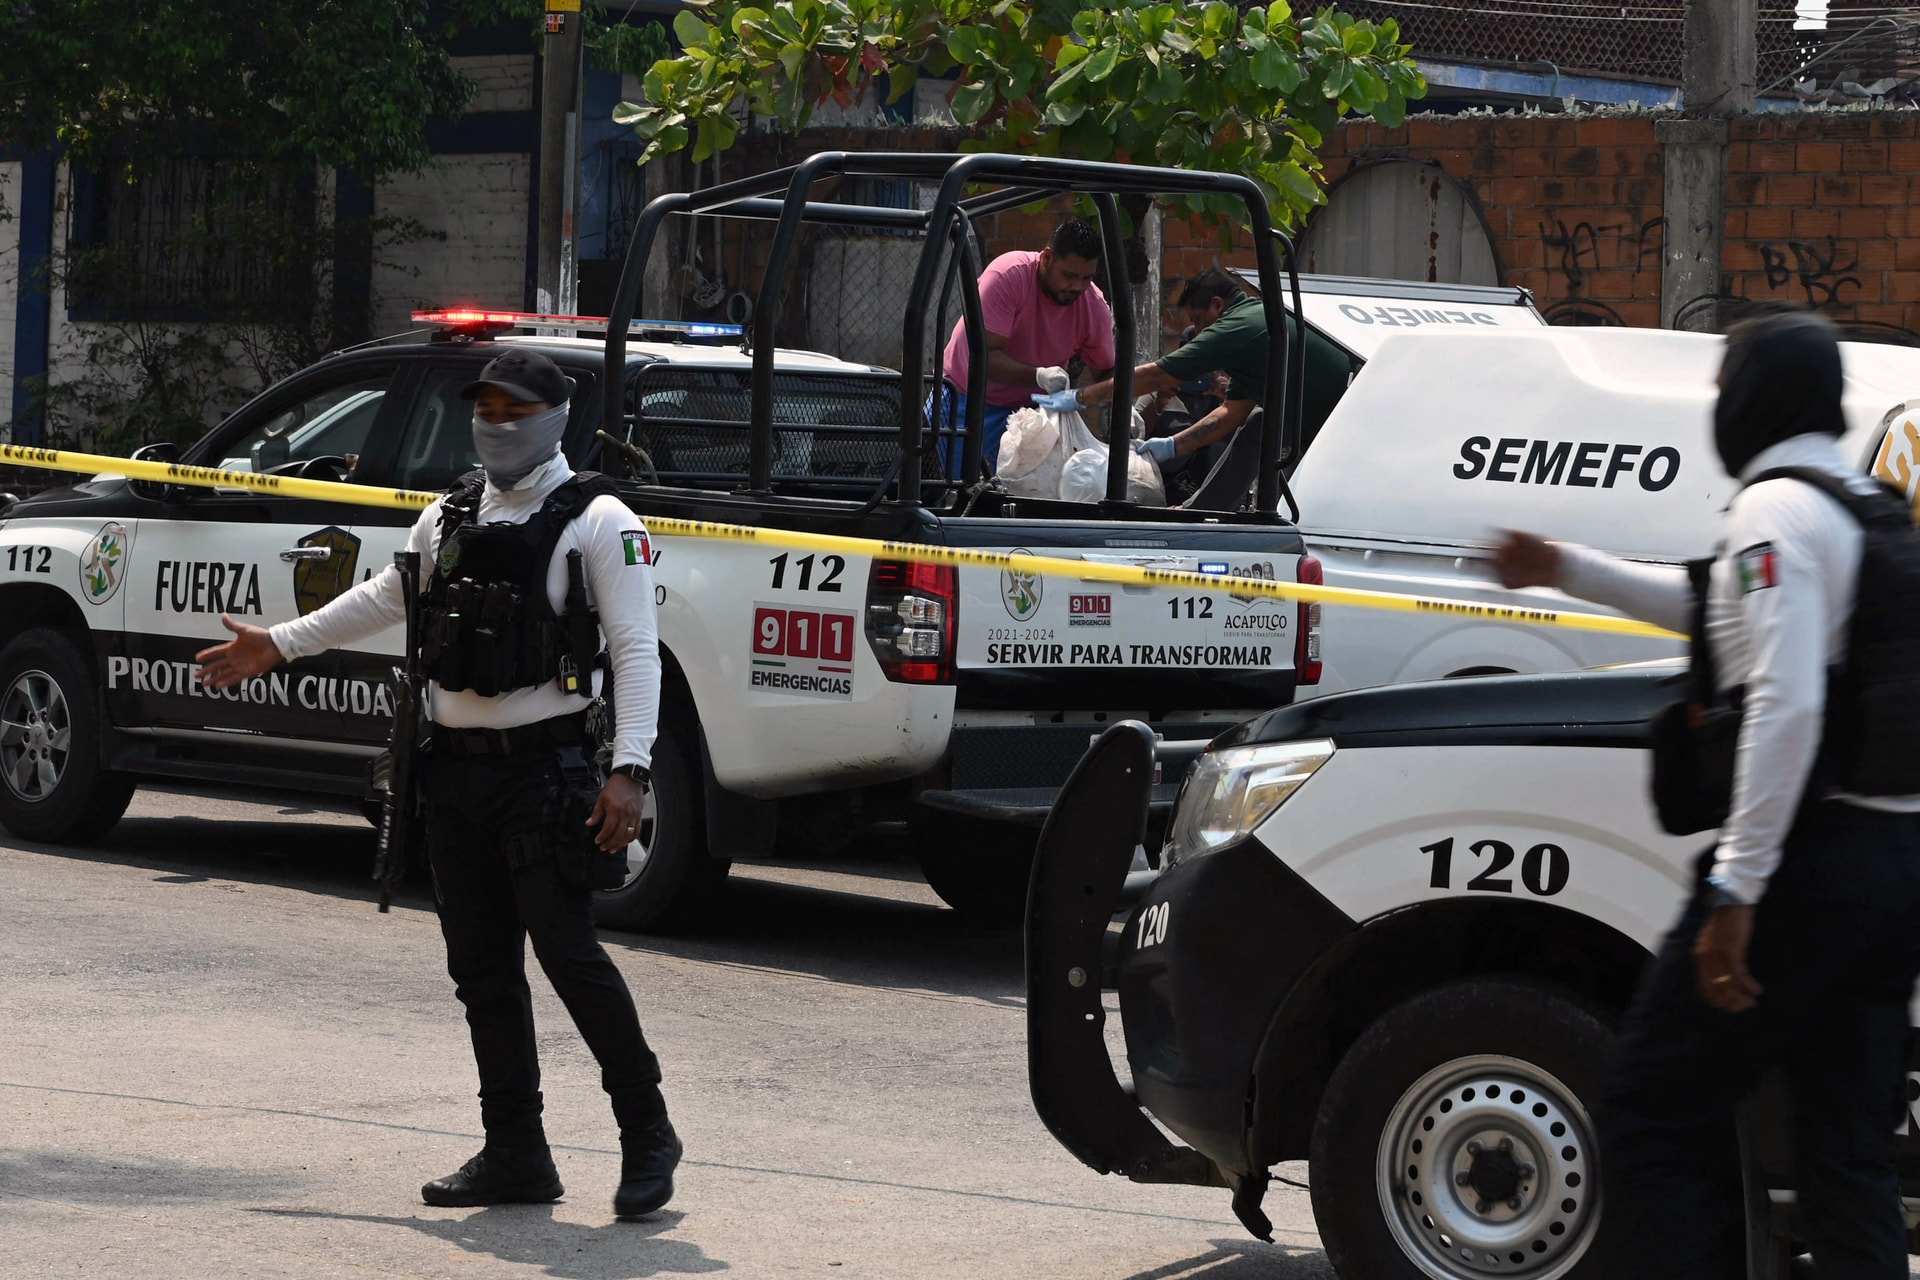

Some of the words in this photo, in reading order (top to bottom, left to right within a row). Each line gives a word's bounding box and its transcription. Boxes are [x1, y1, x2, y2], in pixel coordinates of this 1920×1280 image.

[1453, 436, 1681, 492] SEMEFO
[7, 545, 52, 573] 112
[769, 552, 846, 592] 112
[155, 560, 263, 615] FUERZA
[1072, 598, 1107, 611] 911
[1167, 596, 1213, 619] 112
[760, 615, 844, 655] 911
[987, 628, 1055, 641] 2021-2024
[1224, 614, 1287, 631] ACAPULCO
[986, 643, 1063, 665] SERVIR
[1070, 644, 1123, 665] PARA
[1129, 645, 1272, 666] TRANSFORMAR
[751, 671, 851, 694] EMERGENCIAS
[1418, 836, 1570, 897] 120
[1136, 901, 1170, 950] 120
